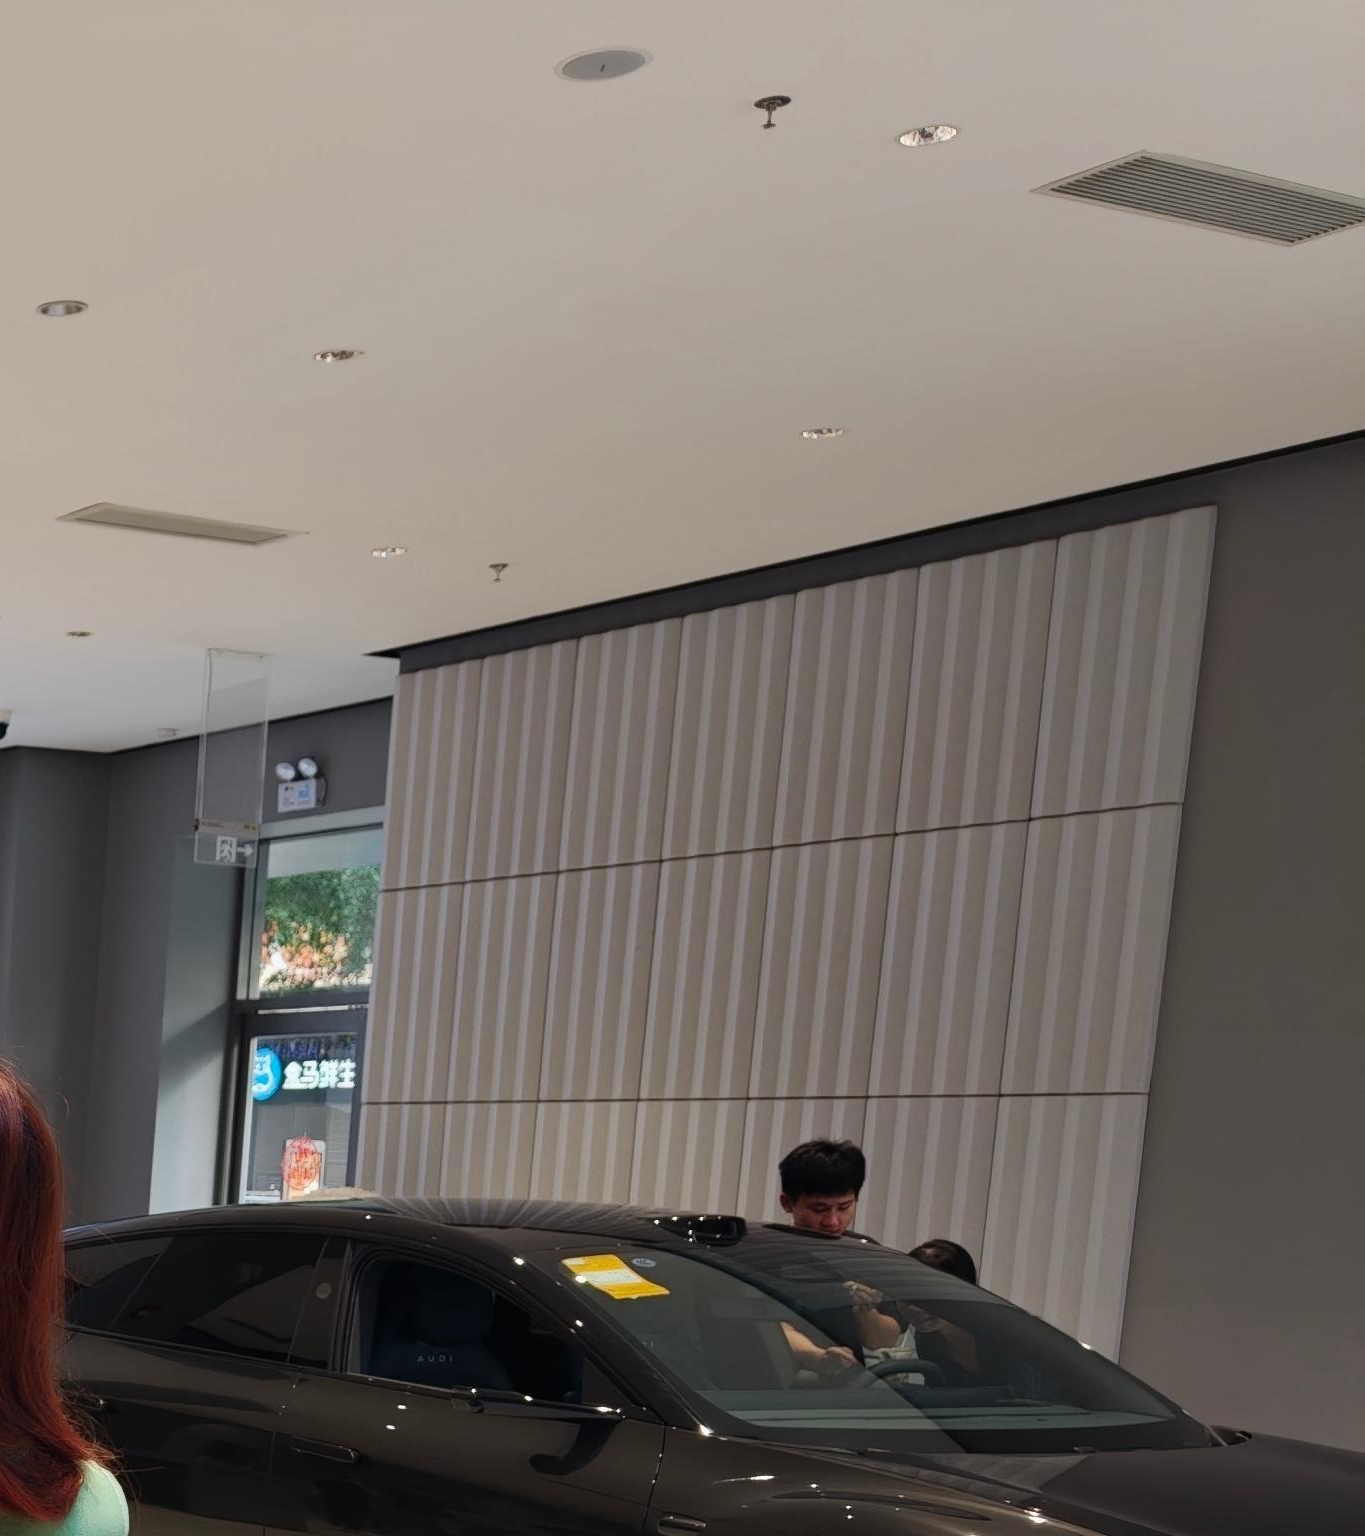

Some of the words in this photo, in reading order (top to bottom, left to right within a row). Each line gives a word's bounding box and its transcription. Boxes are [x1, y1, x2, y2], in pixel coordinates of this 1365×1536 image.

[282, 1058, 357, 1089] 盒马鲜生
[417, 1354, 453, 1362] AUDI
